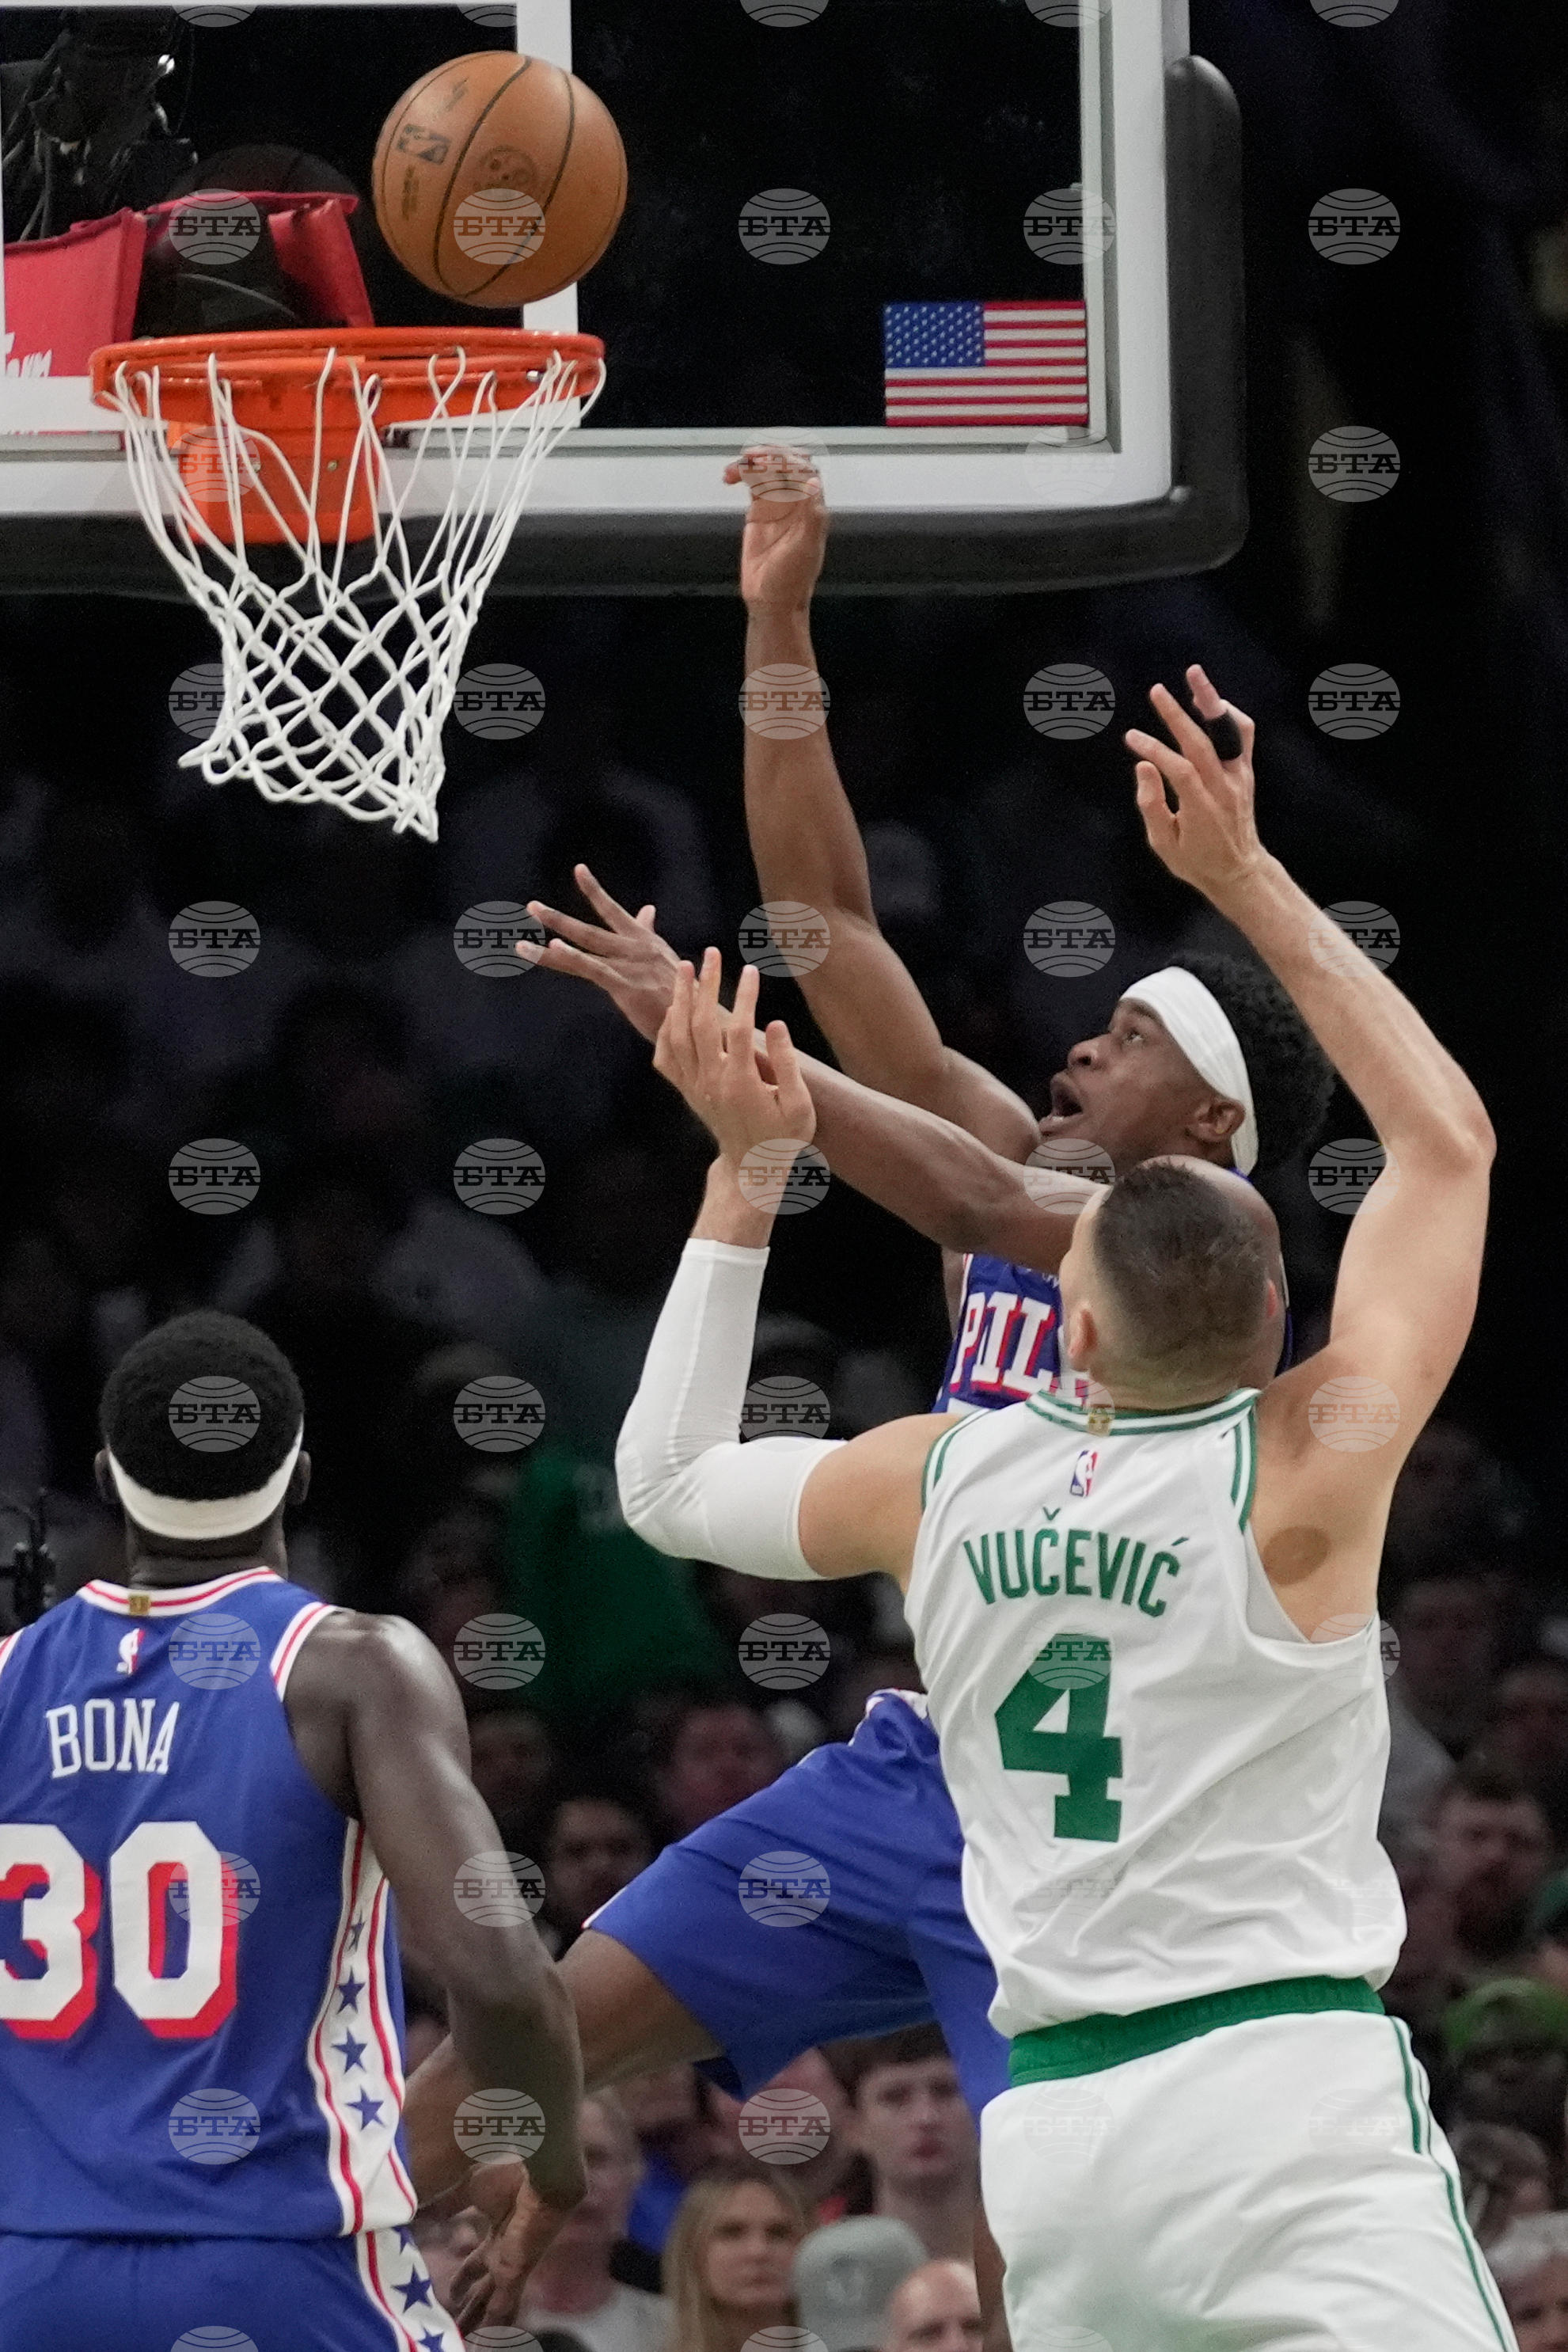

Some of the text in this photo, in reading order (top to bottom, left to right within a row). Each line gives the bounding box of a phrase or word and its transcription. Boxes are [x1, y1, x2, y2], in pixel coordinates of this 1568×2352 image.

[963, 1507, 1189, 1617] VUČEVIĆ
[46, 1698, 180, 1779] BONA
[994, 1633, 1123, 1843] 4
[0, 1821, 238, 2040] 30
